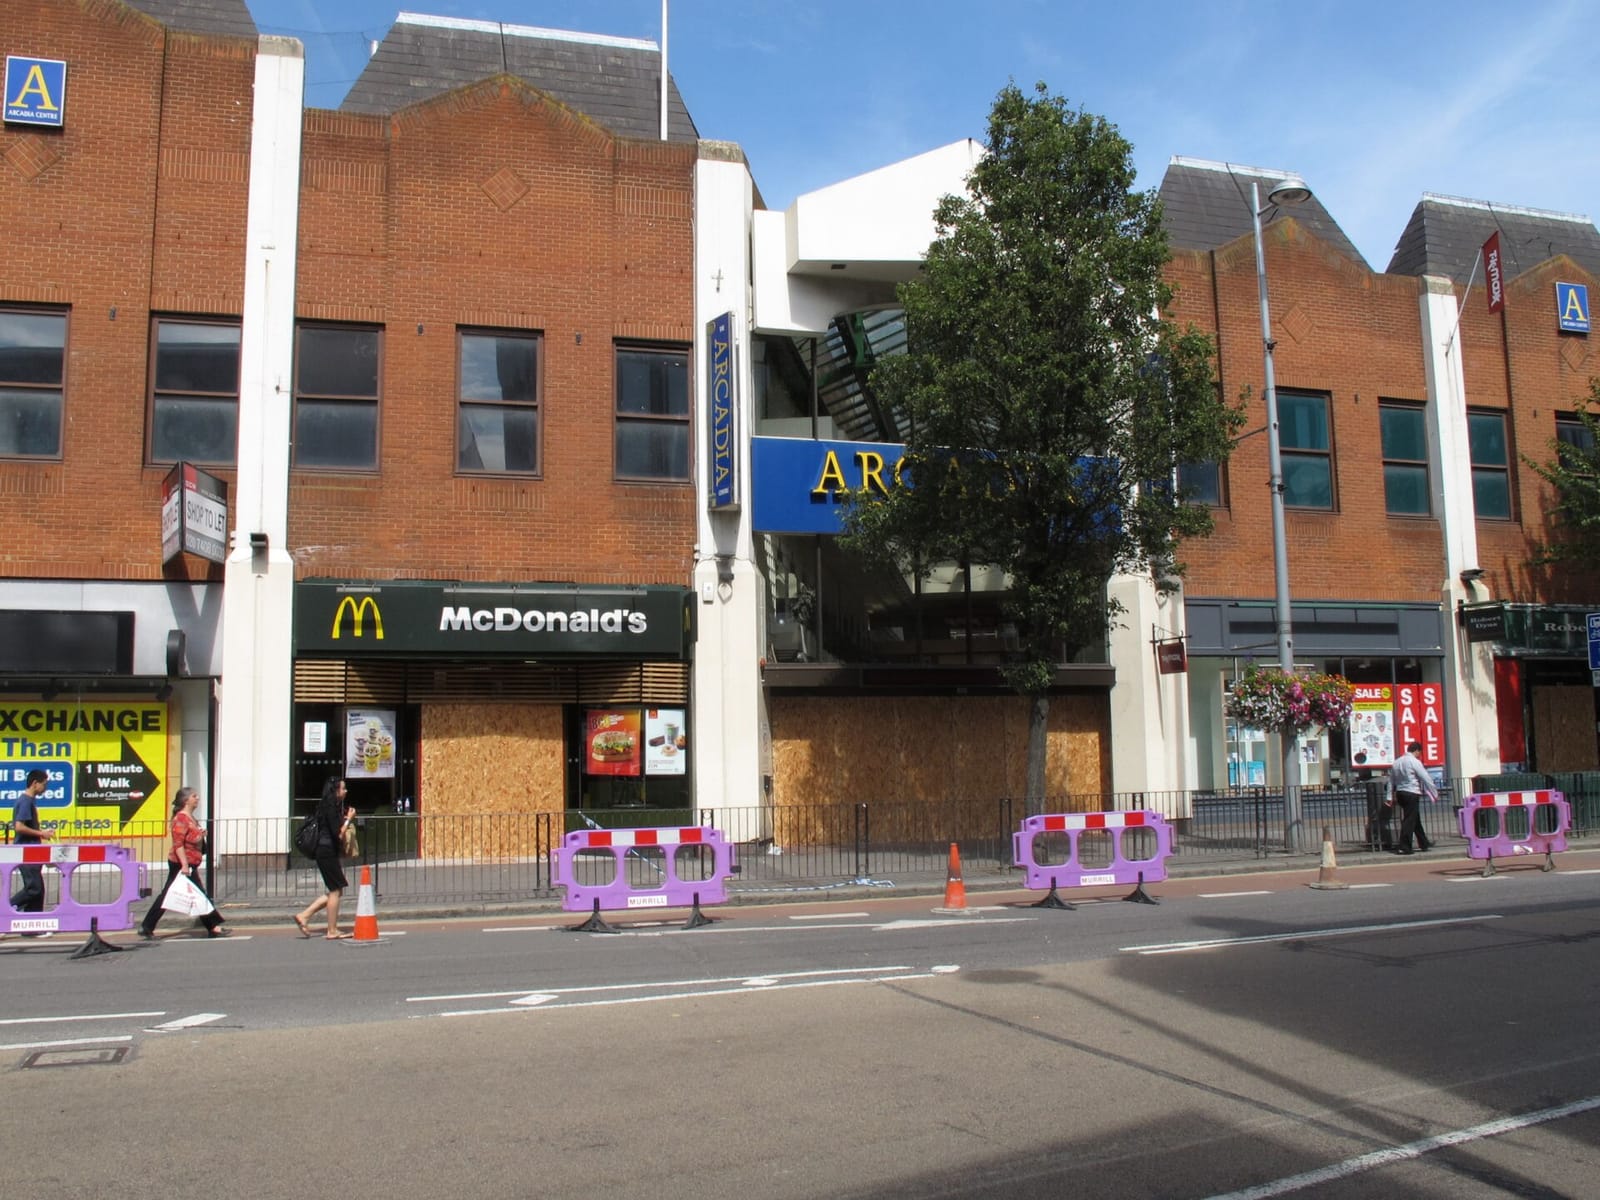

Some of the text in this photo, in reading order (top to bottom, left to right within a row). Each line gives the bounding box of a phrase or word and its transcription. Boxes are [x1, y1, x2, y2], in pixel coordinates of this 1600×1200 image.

[8, 65, 58, 111] A
[1562, 288, 1587, 321] A
[714, 339, 730, 487] ARCADIA
[187, 501, 204, 523] SHOP
[205, 509, 213, 528] TO
[214, 514, 225, 532] LET
[439, 606, 648, 634] McDonald's
[1544, 622, 1586, 632] Robe
[1355, 688, 1382, 698] SALE
[1401, 688, 1416, 753] SAL
[1423, 688, 1438, 761] SALE
[2, 737, 72, 757] Than
[14, 769, 64, 781] Bks
[85, 763, 144, 774] 1 Minute
[97, 777, 130, 788] Walk
[629, 896, 666, 906] MURRILL
[13, 920, 57, 930] MURRILL
